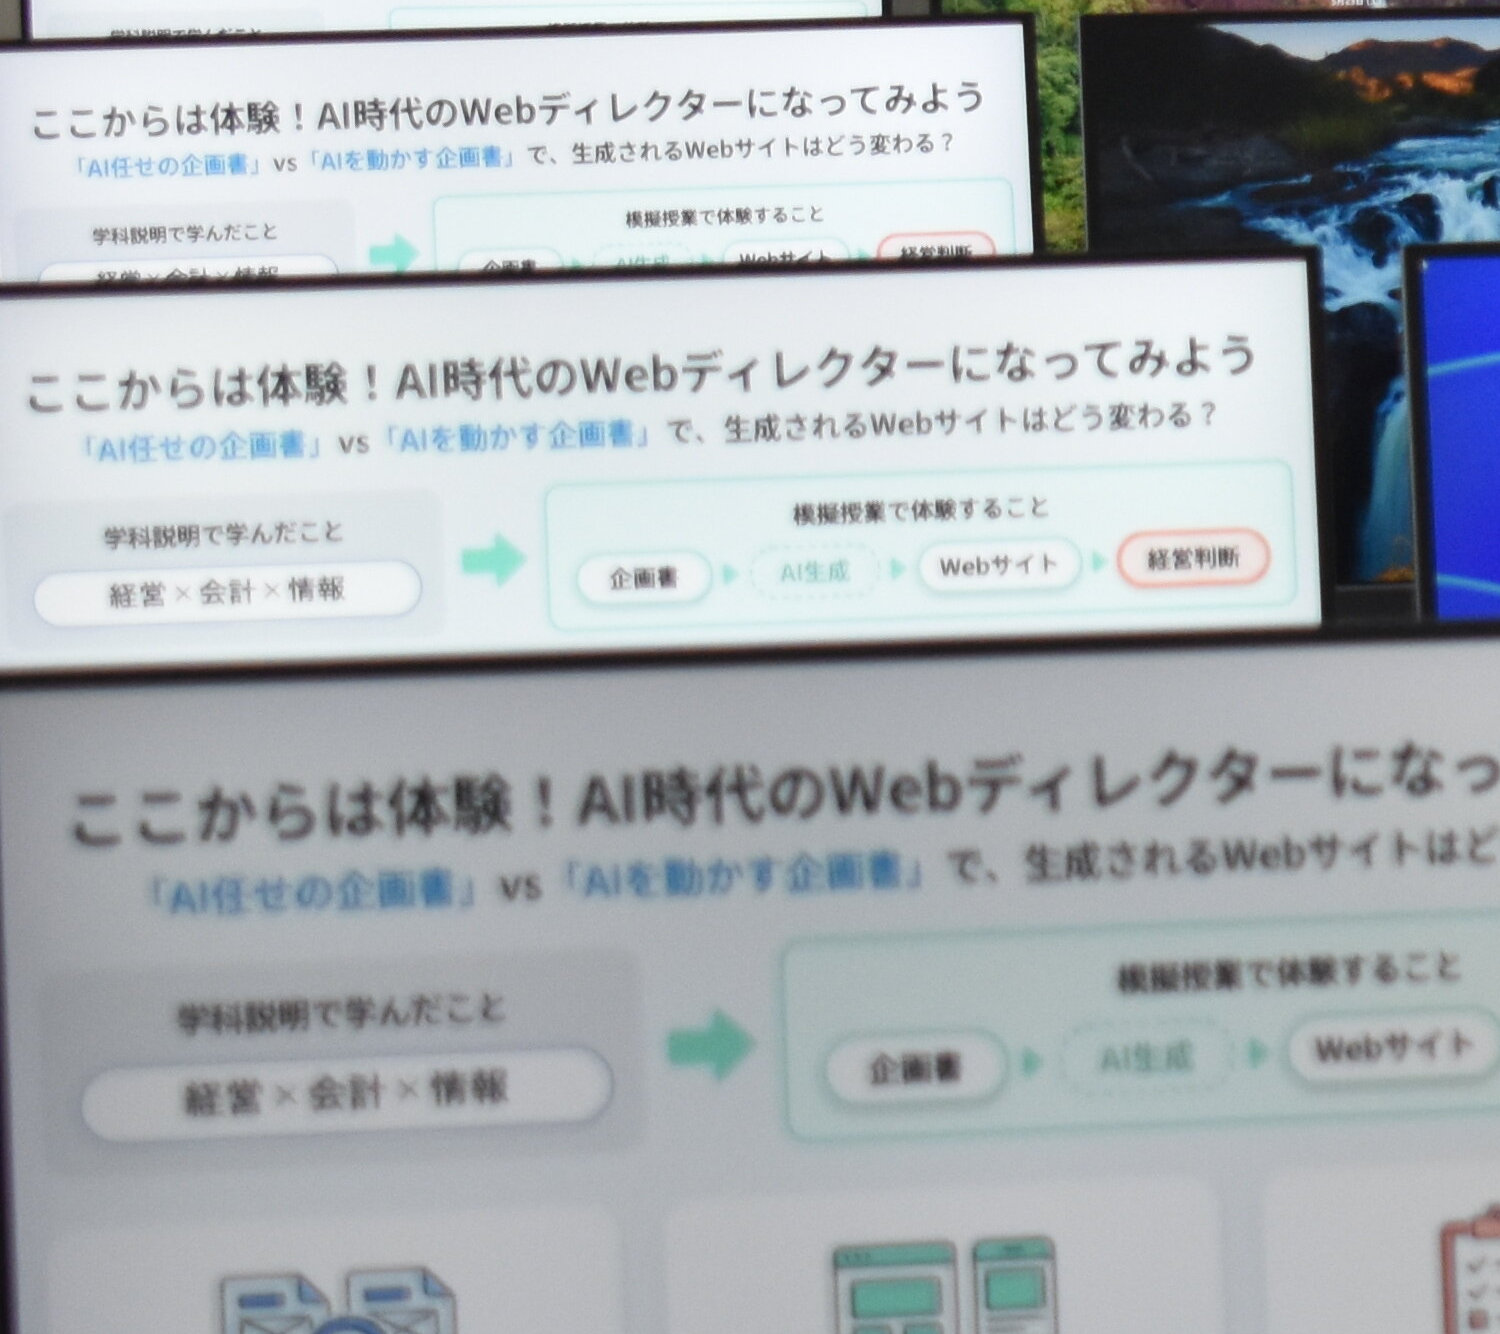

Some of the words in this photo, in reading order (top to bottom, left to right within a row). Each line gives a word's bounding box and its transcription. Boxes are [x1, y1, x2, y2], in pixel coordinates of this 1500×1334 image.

[33, 79, 984, 140] ここからは体験！AI時代のWebディレクターになってみよう
[274, 156, 298, 173] vs
[28, 334, 1256, 414] ここからは体験！AI時代のWebディレクターになってみよう
[338, 433, 371, 455] vs
[940, 552, 1058, 577] Webサイト
[499, 870, 542, 902] vs
[1314, 1027, 1475, 1066] Webサイト
